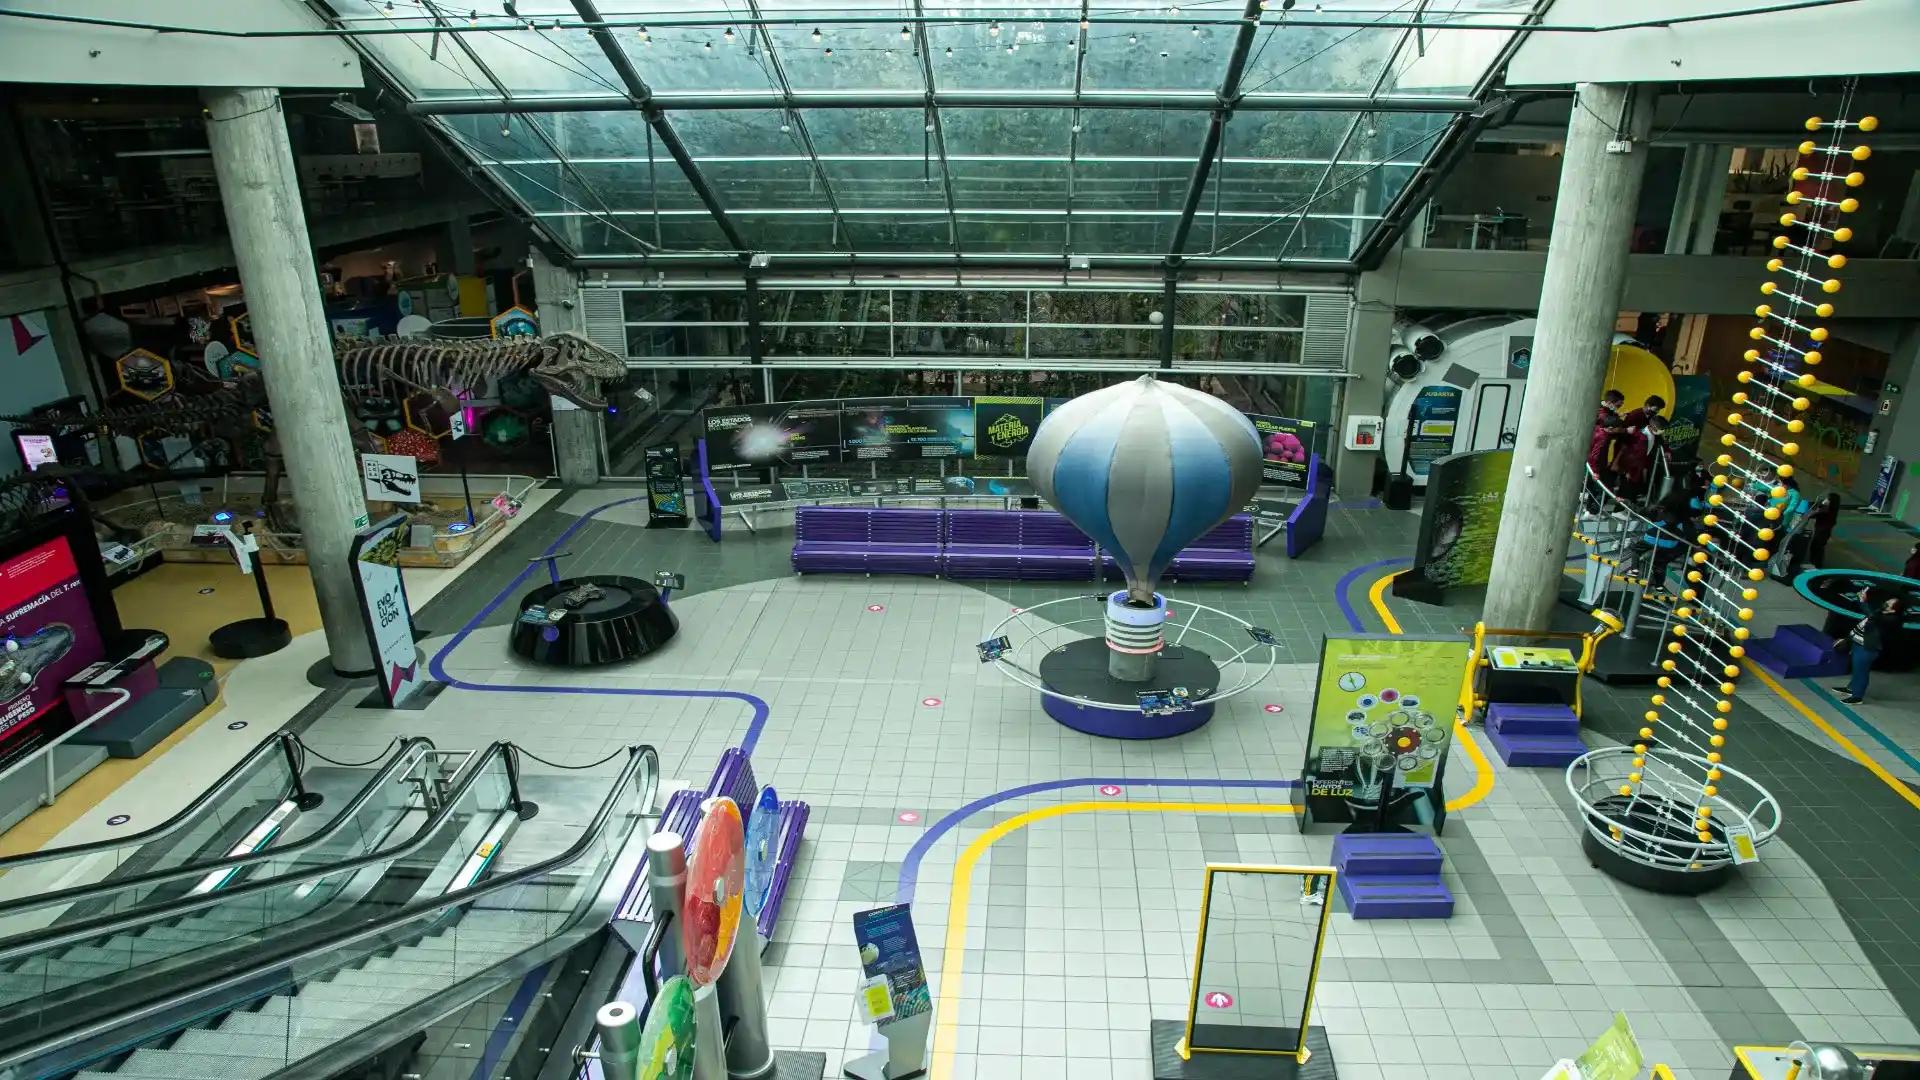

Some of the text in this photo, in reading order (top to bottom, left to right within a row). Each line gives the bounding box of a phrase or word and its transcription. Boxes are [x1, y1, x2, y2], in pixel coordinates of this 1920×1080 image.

[988, 421, 1021, 434] MATERIA
[5, 594, 51, 622] SUPREMACÍA
[50, 588, 64, 599] DEL
[70, 579, 81, 589] rex
[376, 592, 392, 610] EVO
[379, 606, 388, 619] LU
[1311, 788, 1354, 796] DE LUZ
